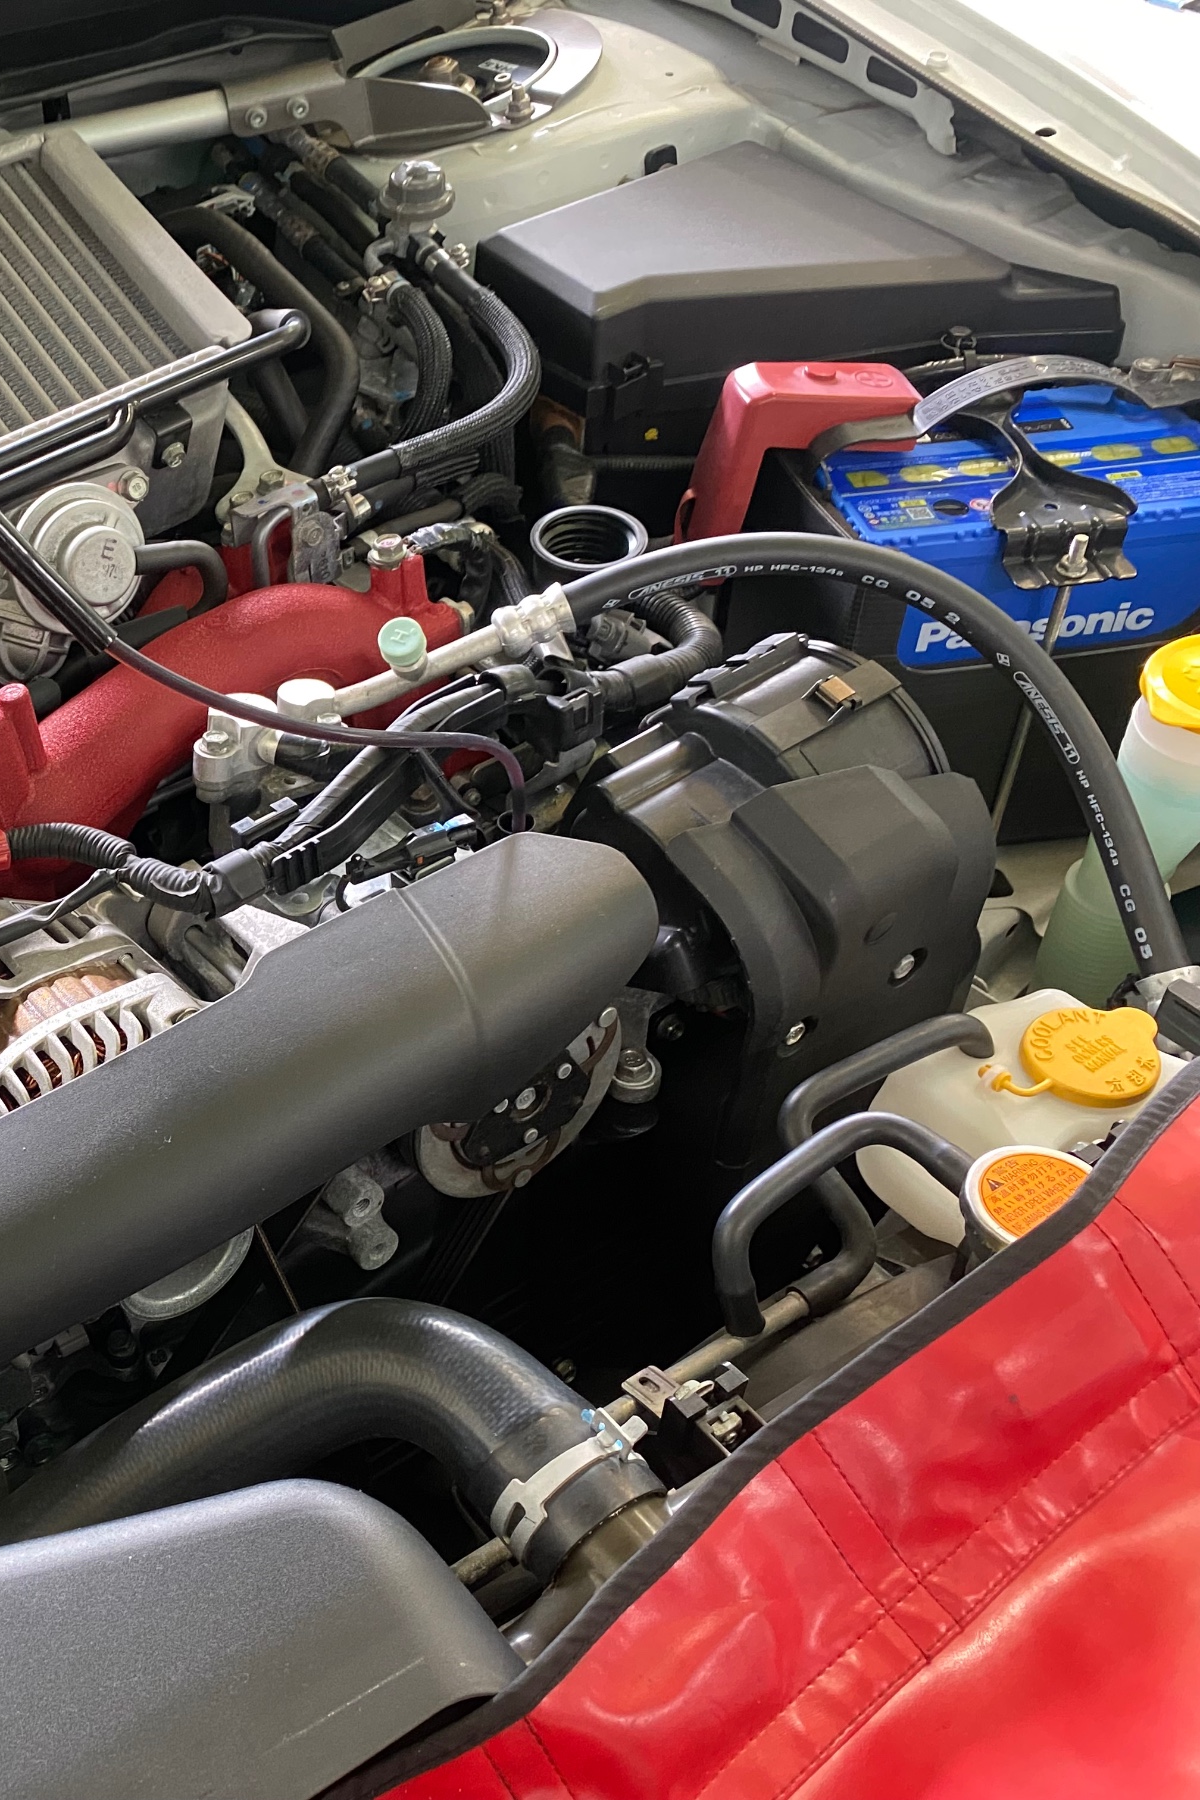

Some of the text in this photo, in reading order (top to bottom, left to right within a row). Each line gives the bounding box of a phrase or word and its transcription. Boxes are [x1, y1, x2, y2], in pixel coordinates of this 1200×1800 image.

[744, 564, 764, 573] HP
[770, 564, 844, 577] HFC-134a
[1076, 770, 1090, 788] HP
[1087, 793, 1120, 867] HFC-134a
[1030, 1010, 1107, 1062] COOLANT
[1065, 1035, 1092, 1053] SEE
[1084, 1043, 1128, 1073] MANUAL
[1000, 1159, 1039, 1183] WARNING
[1002, 1205, 1028, 1223] NEVER
[1024, 1193, 1047, 1210] OPEN
[1043, 1180, 1068, 1198] WHEN
